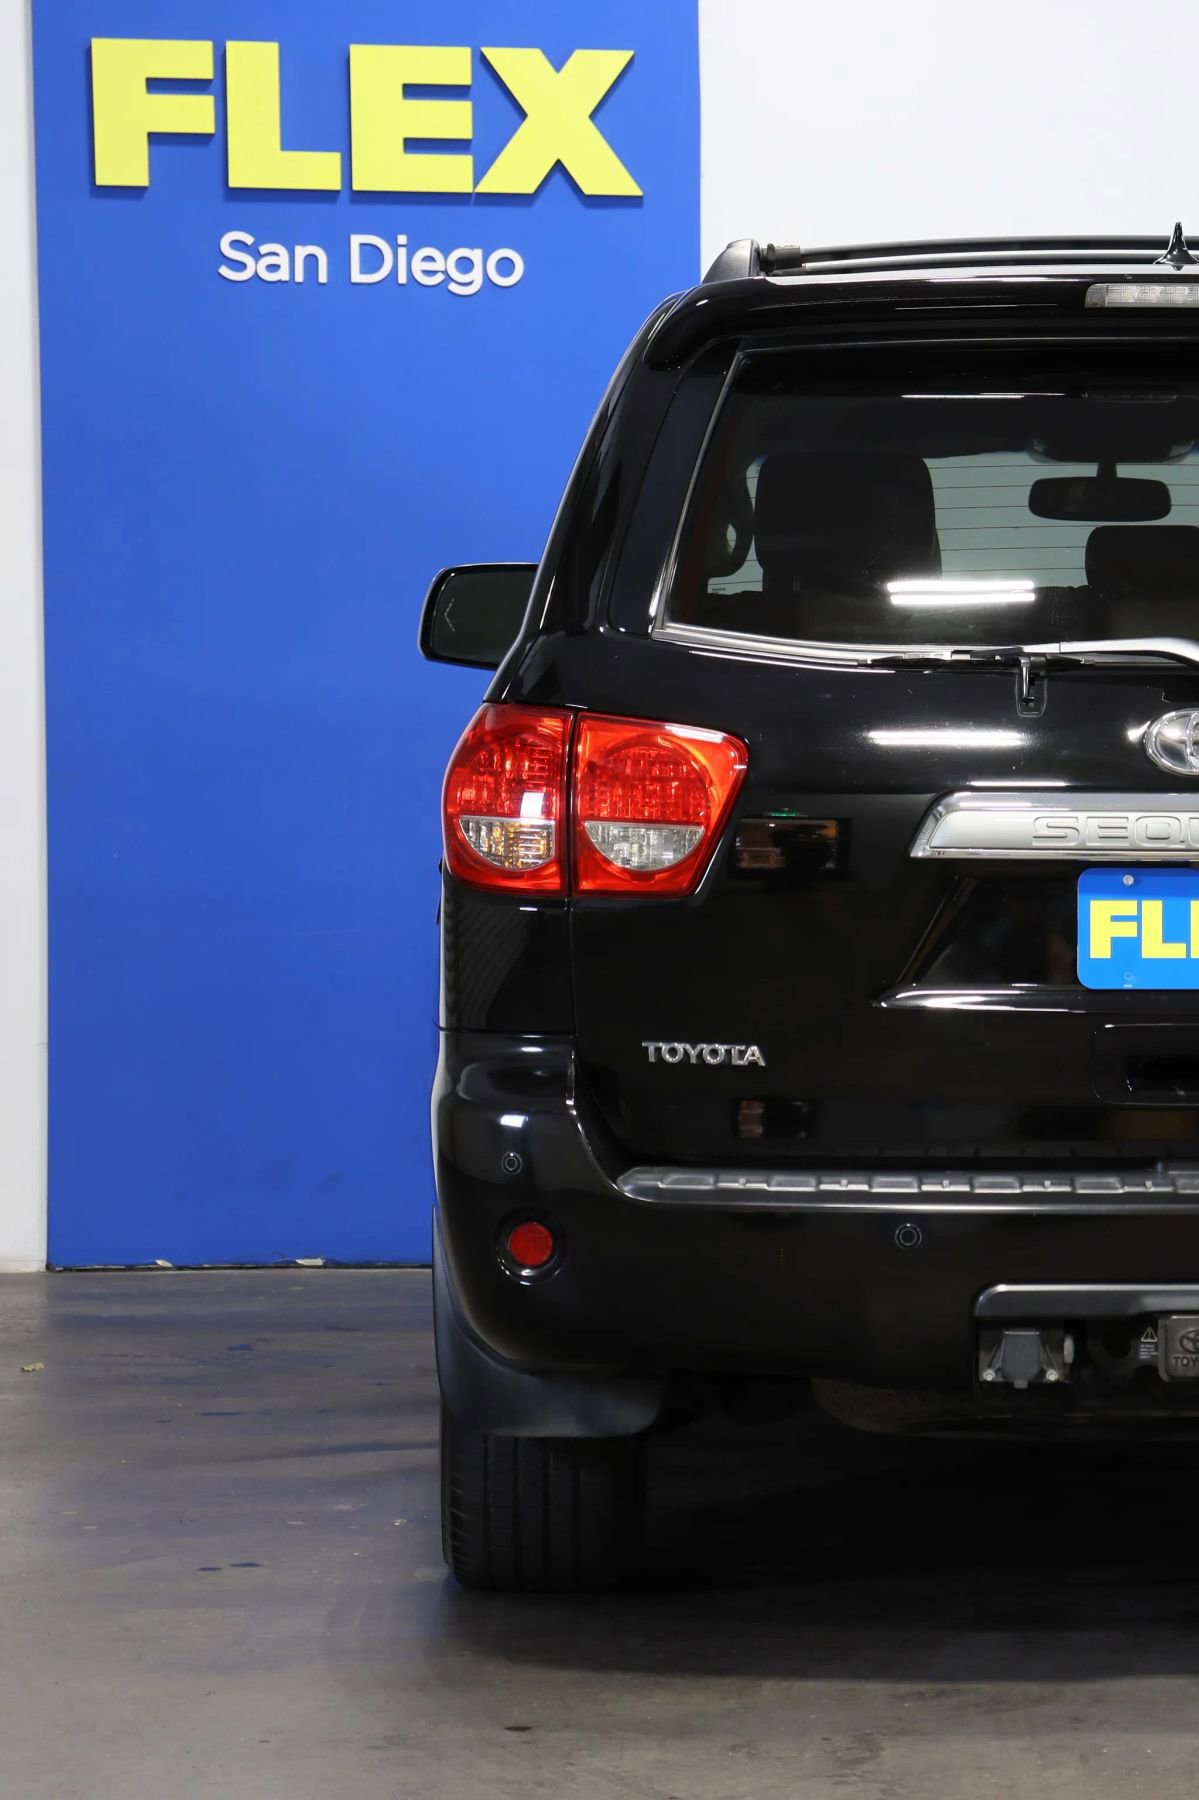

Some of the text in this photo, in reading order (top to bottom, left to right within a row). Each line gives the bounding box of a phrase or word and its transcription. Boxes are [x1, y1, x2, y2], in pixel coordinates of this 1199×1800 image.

[90, 38, 643, 197] FLEX
[218, 231, 525, 296] San Diego
[642, 1041, 766, 1066] TOYOTA
